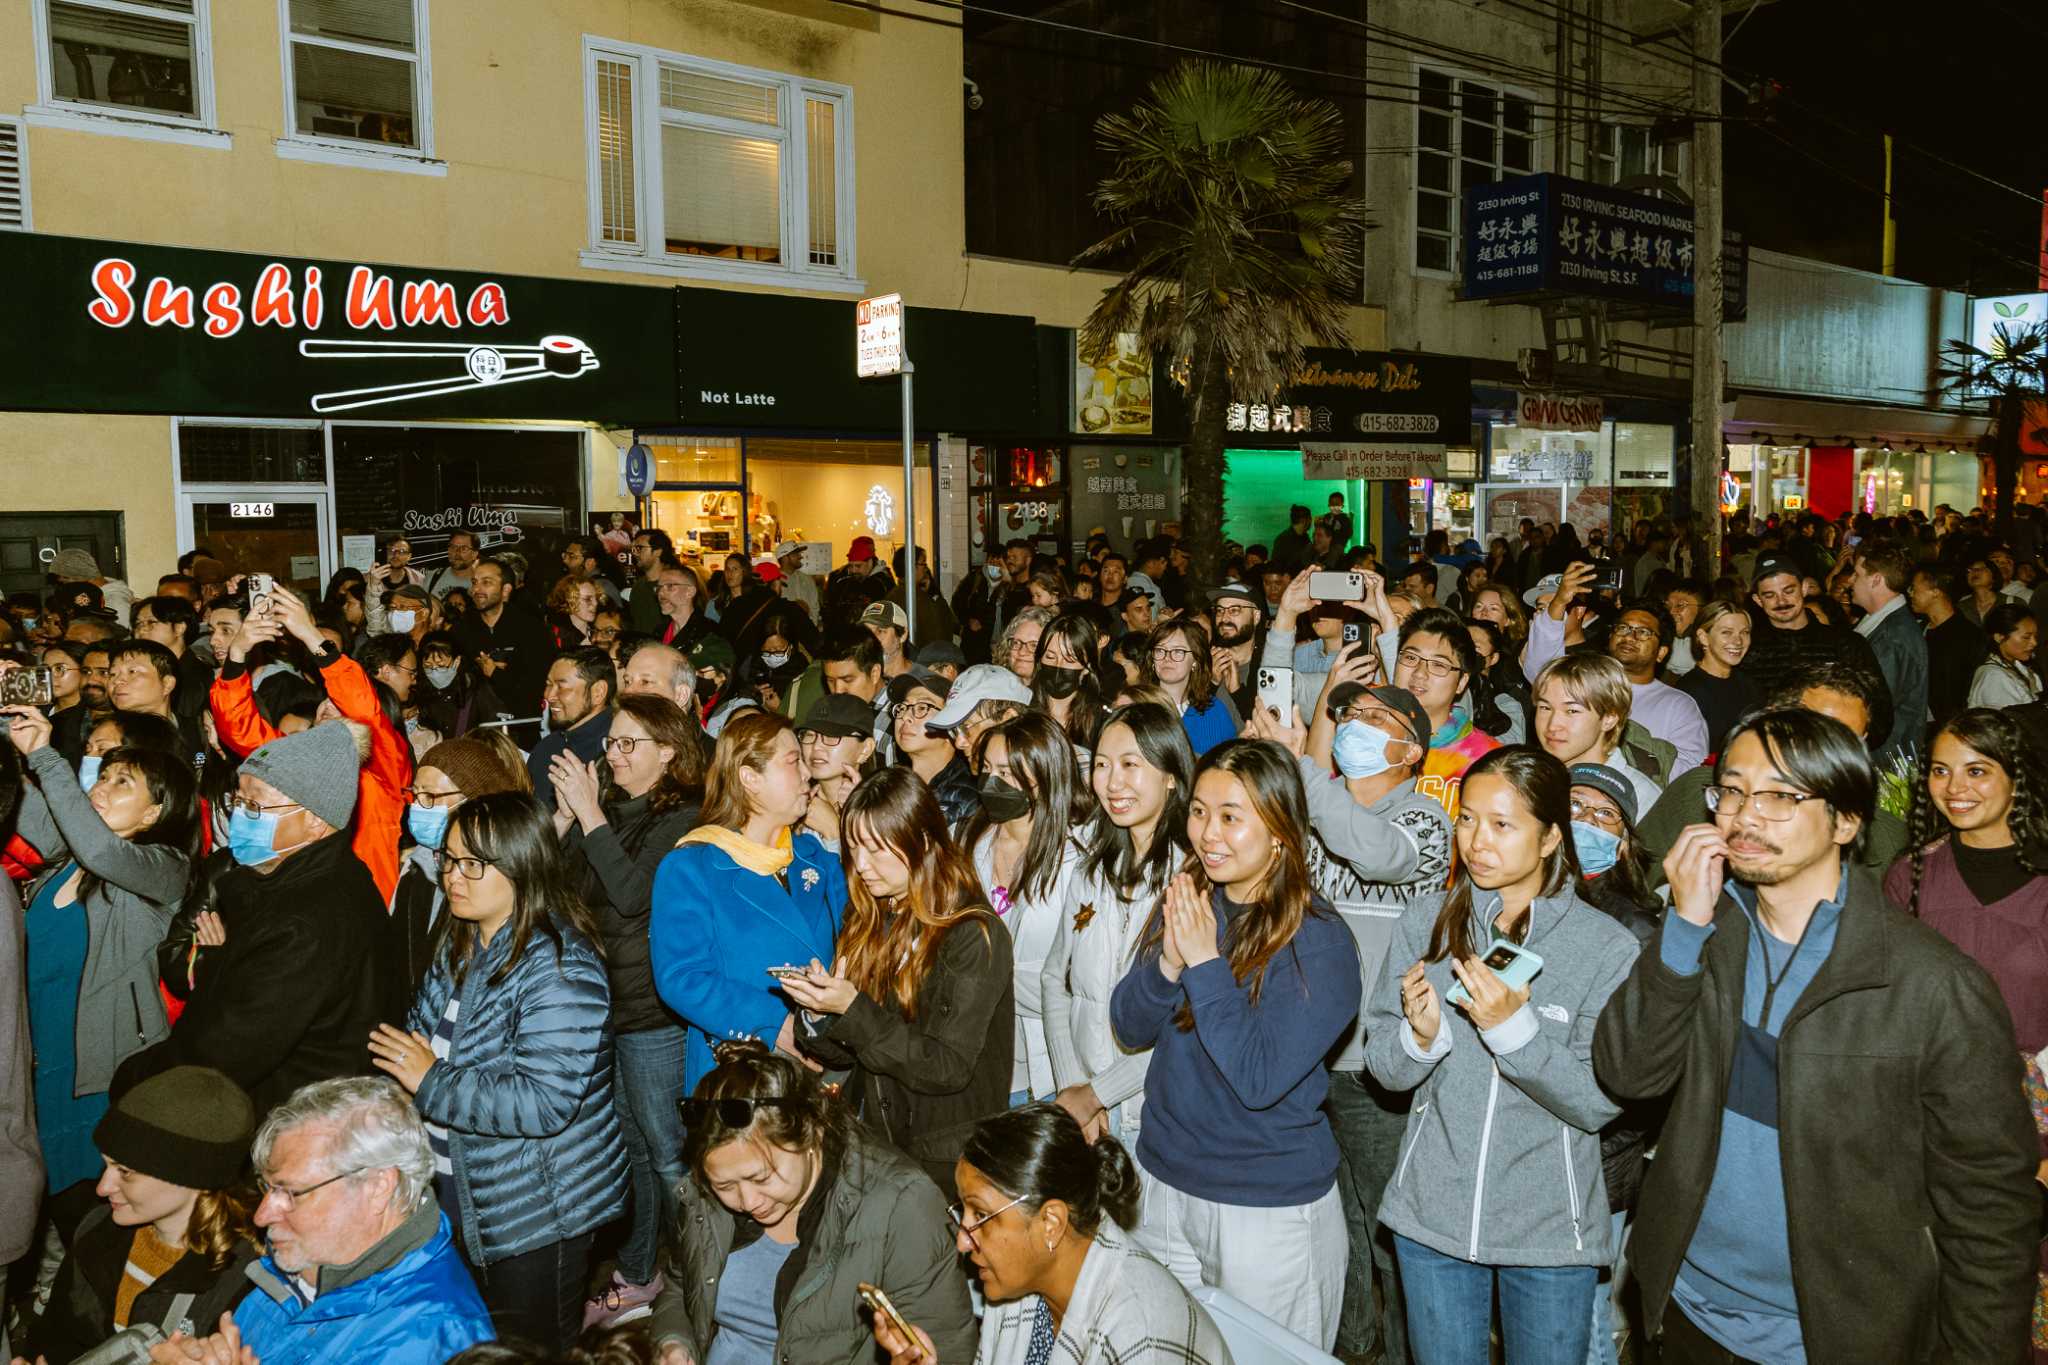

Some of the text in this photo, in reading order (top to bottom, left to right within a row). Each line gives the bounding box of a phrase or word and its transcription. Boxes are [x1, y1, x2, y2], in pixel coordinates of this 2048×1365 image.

[1478, 192, 1539, 211] 2130 Irving St
[1561, 192, 1694, 233] 2130 IRVING SEAFOOD MARKE
[1559, 215, 1694, 276] 好永興超級市
[1477, 264, 1538, 281] 415-681-1188
[1560, 261, 1580, 278] 2130
[1582, 264, 1609, 282] Irving
[88, 258, 510, 338] Sushi Uma
[872, 303, 899, 319] PARKING
[1383, 361, 1421, 392] Deli
[701, 390, 776, 405] Not Latte
[1362, 415, 1436, 432] 415-682-3828
[1306, 450, 1332, 461] Please
[1360, 450, 1383, 462] Order
[1386, 451, 1411, 462] Before
[1411, 451, 1442, 462] Takeout
[233, 504, 272, 516] 2146
[403, 506, 519, 531] Sushi Uma
[1013, 502, 1048, 519] 2138
